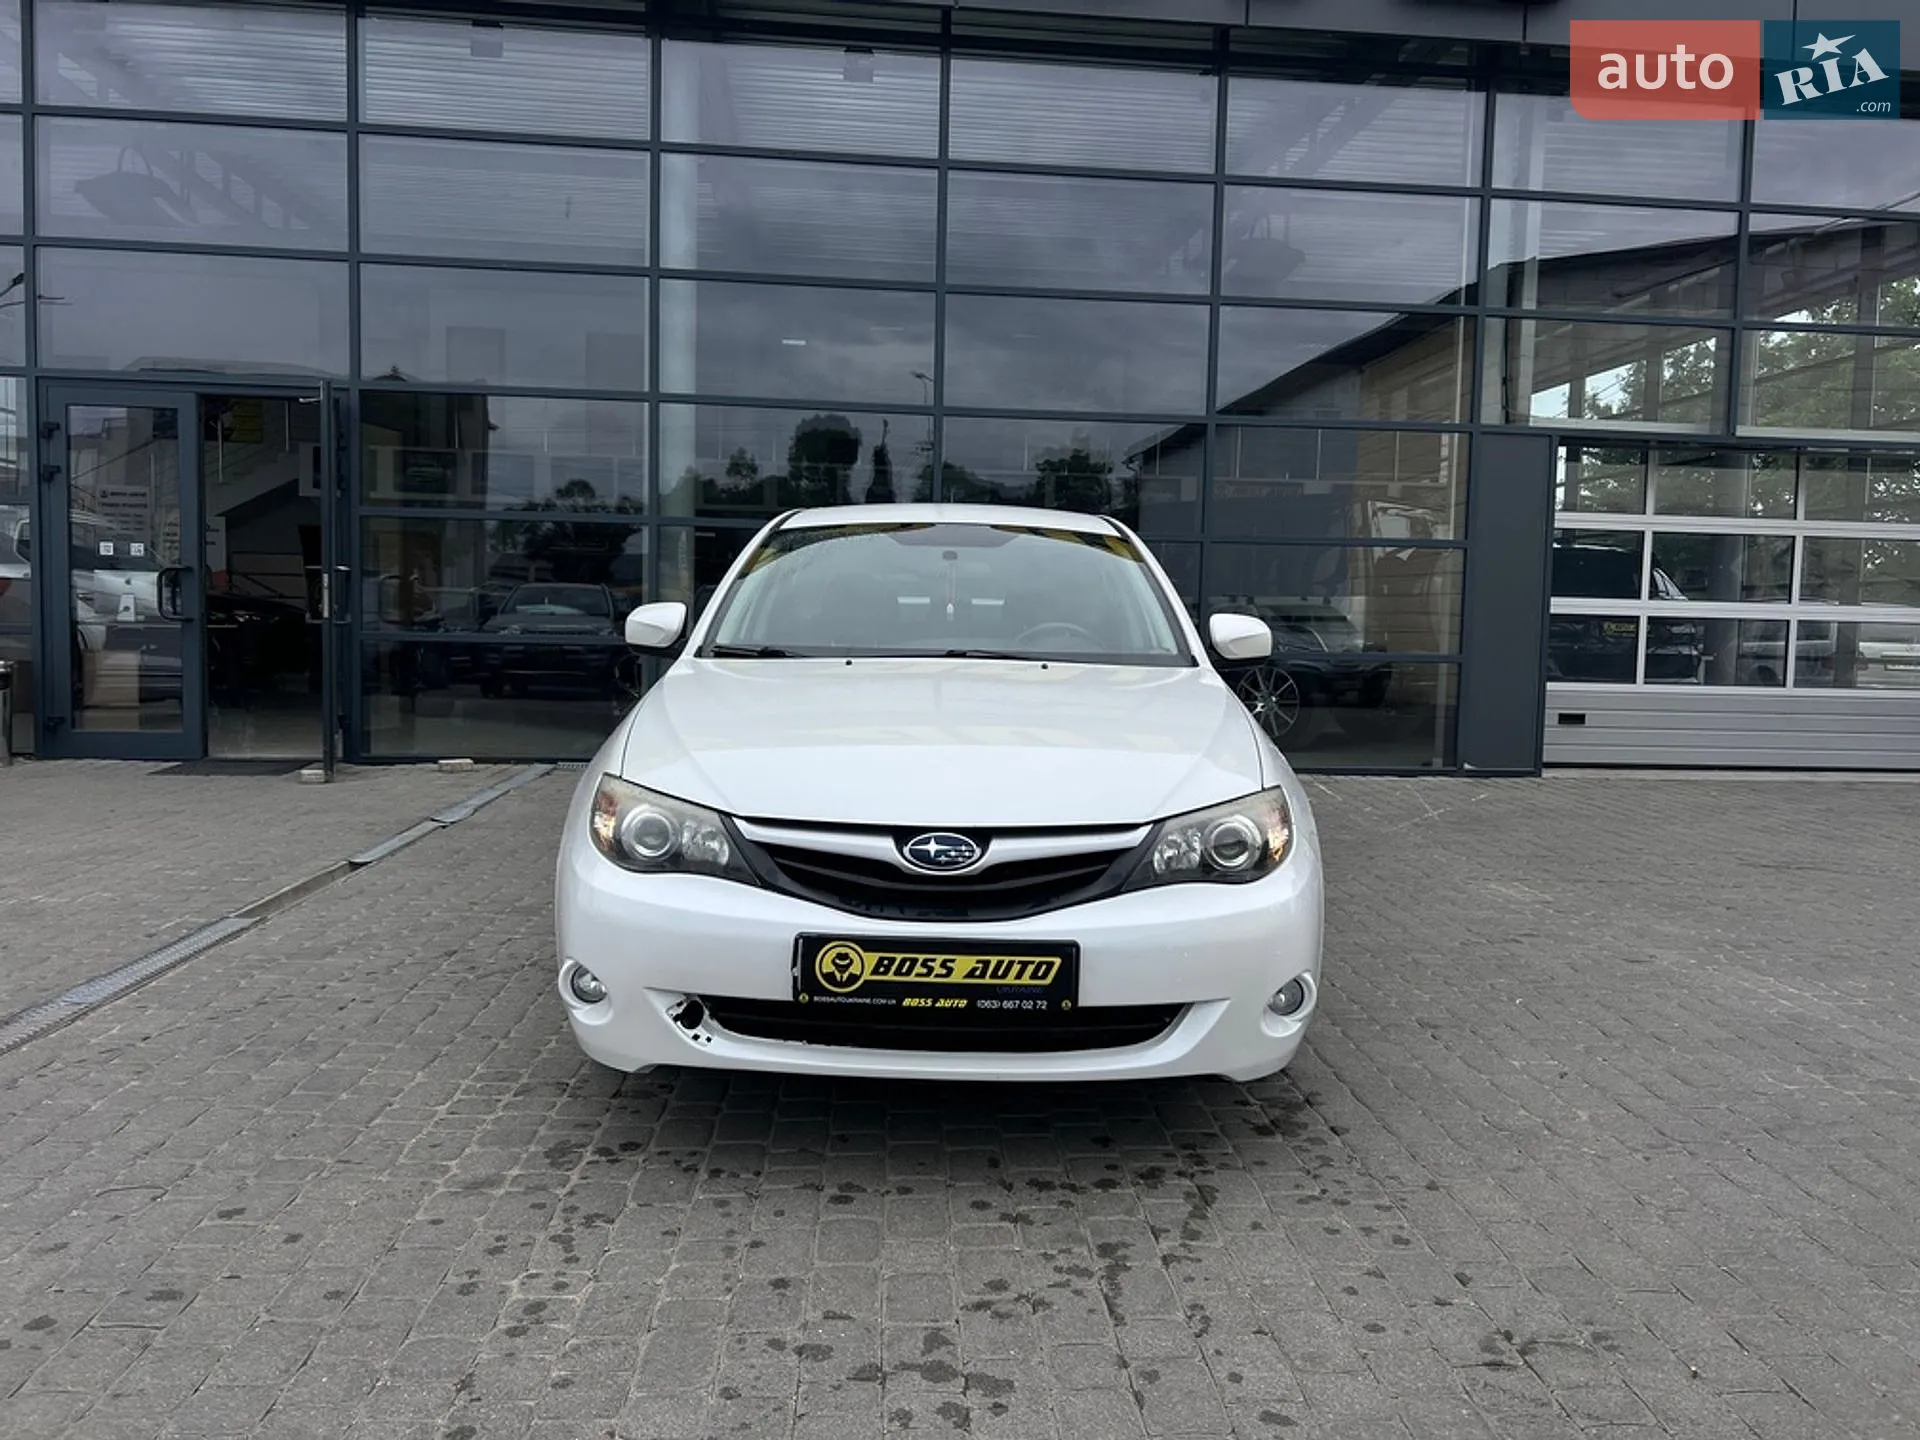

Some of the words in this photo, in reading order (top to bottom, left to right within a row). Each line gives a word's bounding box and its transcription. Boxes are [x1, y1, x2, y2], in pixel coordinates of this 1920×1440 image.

[869, 956, 957, 979] BOSS
[962, 958, 1057, 981] AUTO
[902, 997, 933, 1007] BOSS
[935, 998, 968, 1008] AUTO
[976, 999, 1000, 1009] (063)
[1002, 1000, 1019, 1009] 667
[1021, 1000, 1033, 1009] 02
[1036, 1000, 1048, 1010] 72
